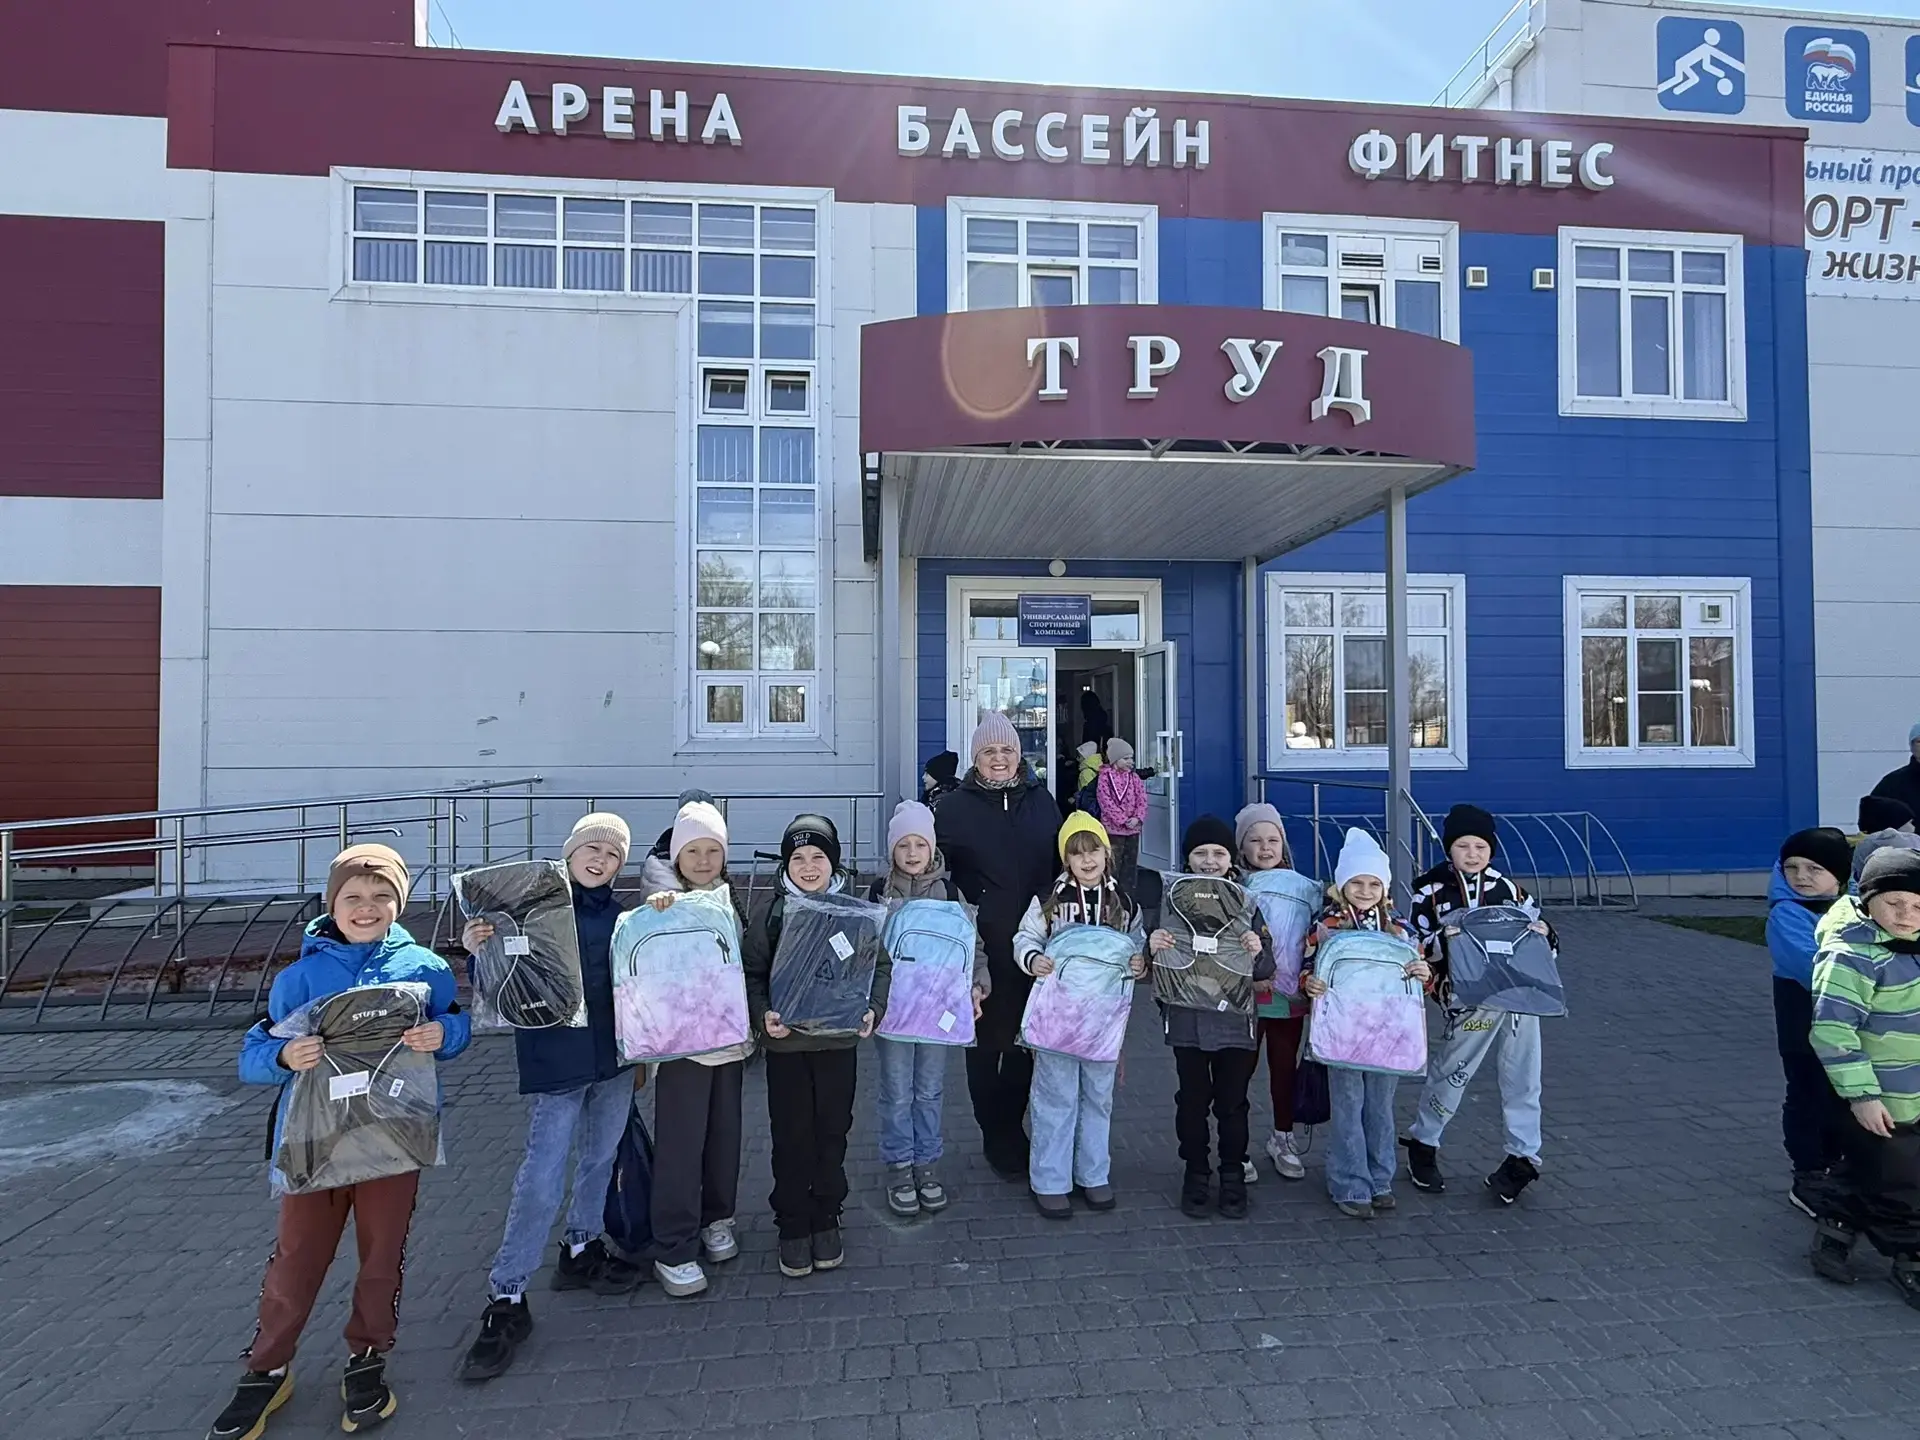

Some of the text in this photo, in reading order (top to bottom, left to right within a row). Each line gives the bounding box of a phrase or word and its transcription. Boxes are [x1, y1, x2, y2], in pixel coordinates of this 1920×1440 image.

[1805, 91, 1853, 102] ЕДИНАЯ
[1805, 101, 1853, 114] РОССИЯ
[495, 80, 1614, 191] АРЕНА БАССЕЙН ФИТНЕС
[1805, 157, 1872, 182] ьный
[1805, 193, 1905, 241] ОРТ
[1026, 335, 1371, 426] ТРУД
[1022, 613, 1087, 621] УНИВЕРСАЛЬНЫЙ
